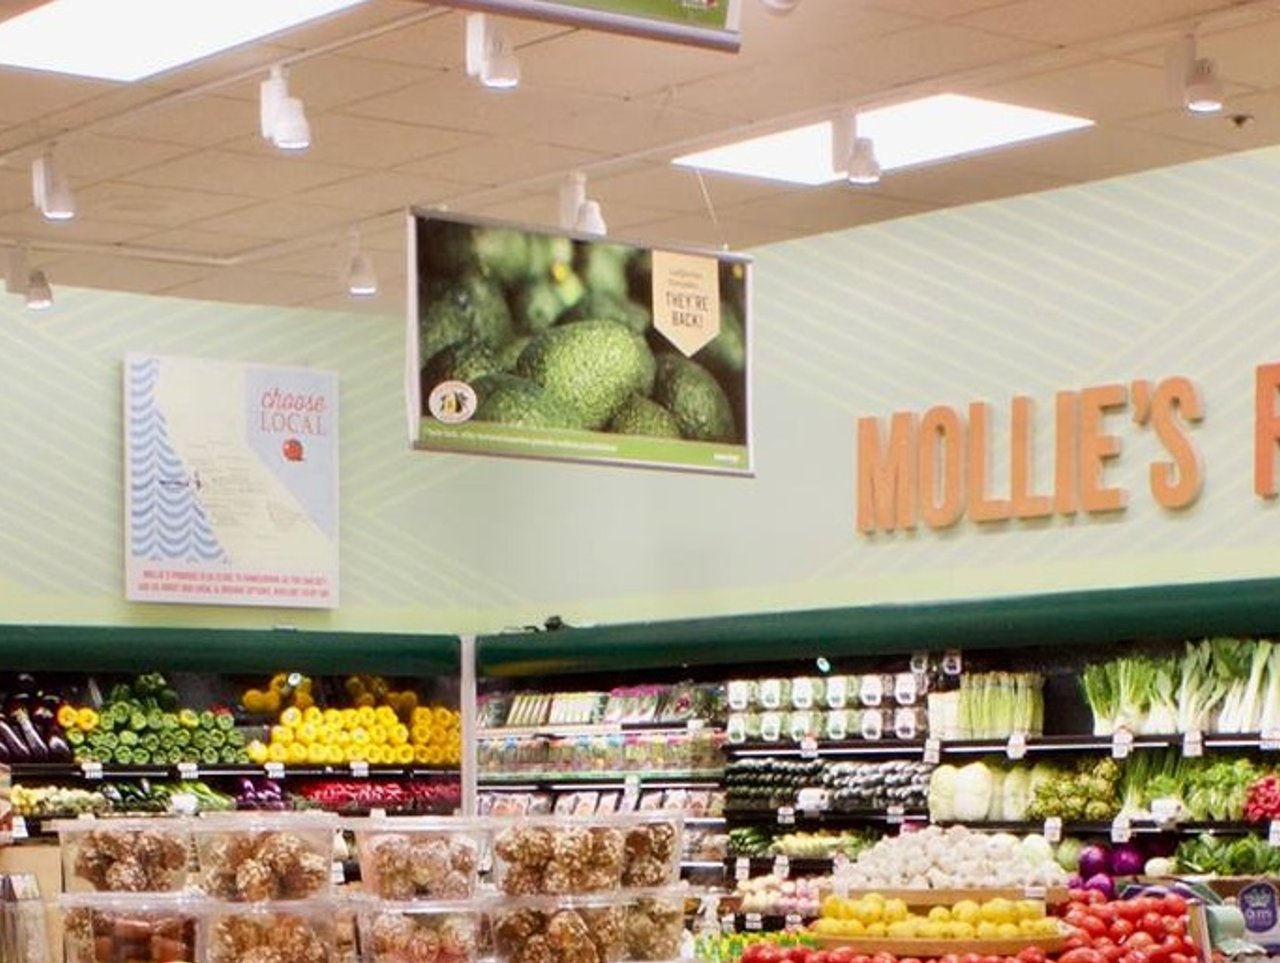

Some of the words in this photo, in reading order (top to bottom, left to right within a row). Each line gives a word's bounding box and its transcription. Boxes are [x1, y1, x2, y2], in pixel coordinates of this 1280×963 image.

[666, 290, 710, 313] THEY'RE
[671, 310, 704, 330] BACK!
[261, 387, 327, 413] choose
[261, 411, 327, 435] LOCAL
[856, 374, 1205, 535] MOLLIE'S
